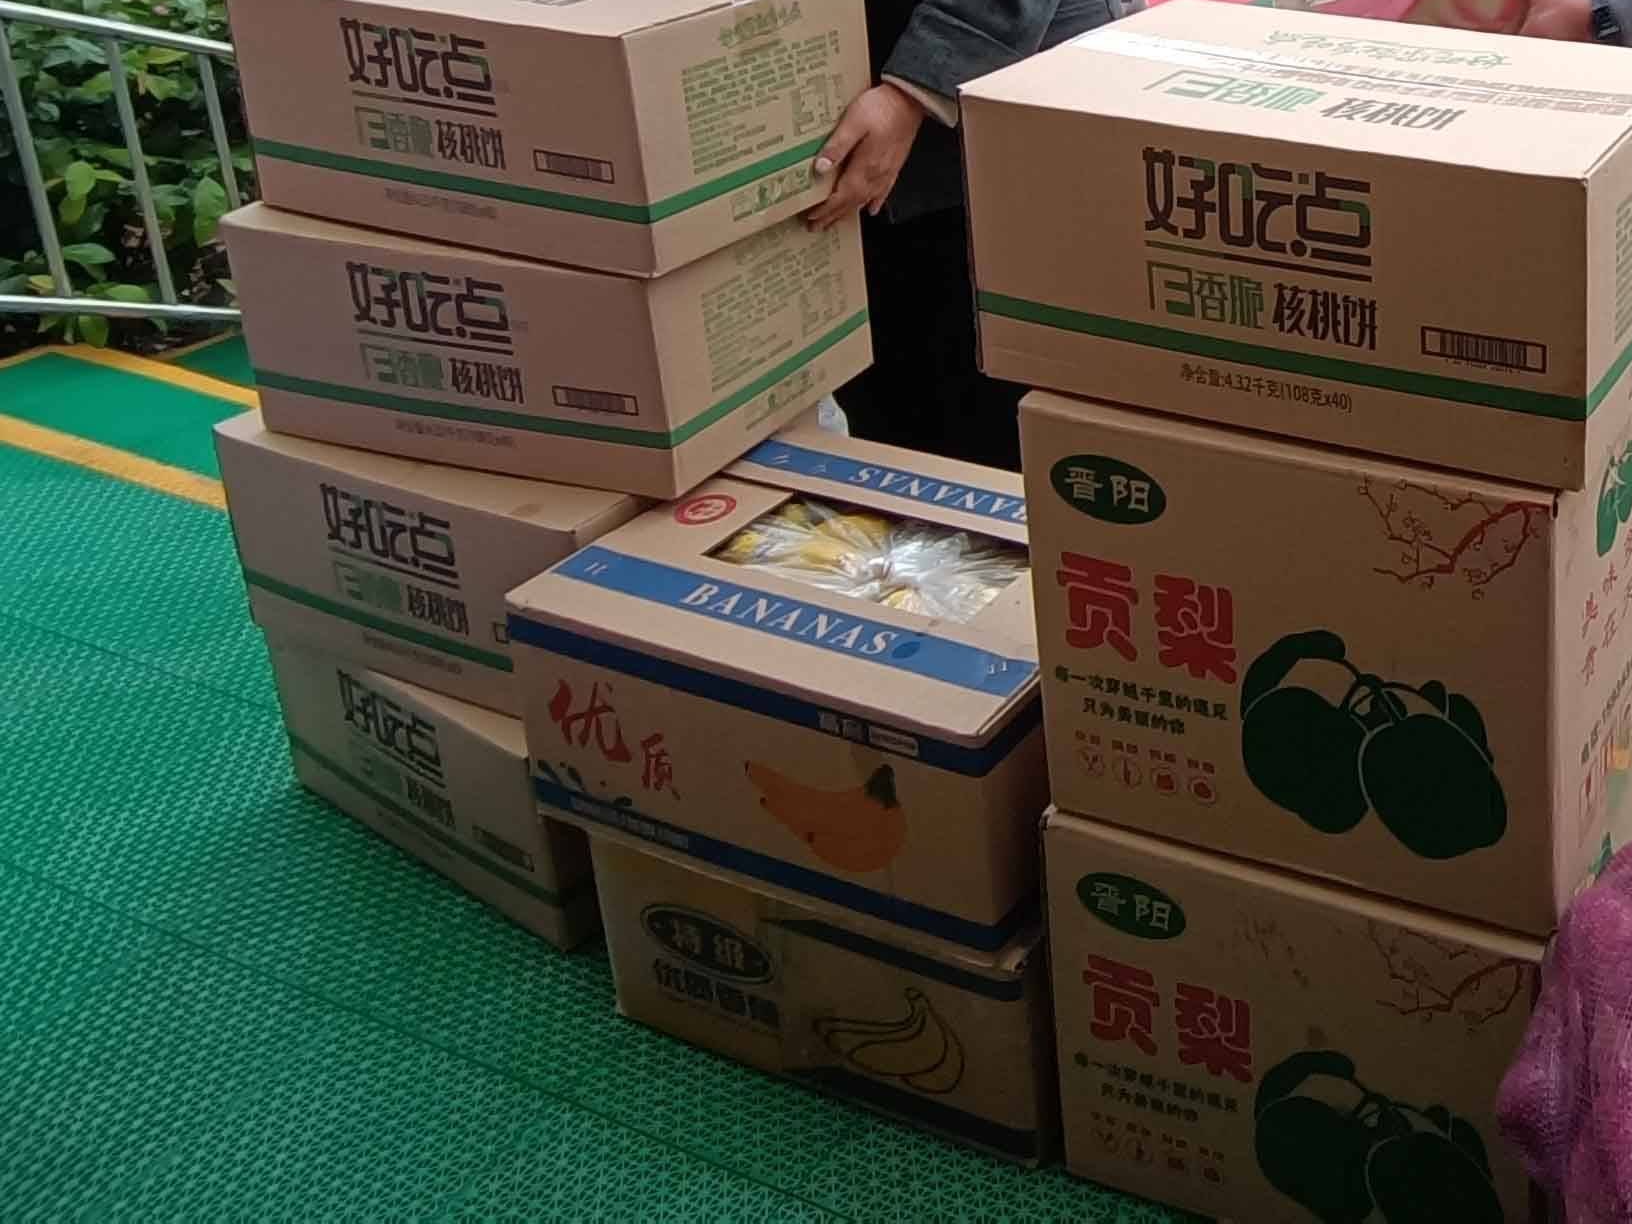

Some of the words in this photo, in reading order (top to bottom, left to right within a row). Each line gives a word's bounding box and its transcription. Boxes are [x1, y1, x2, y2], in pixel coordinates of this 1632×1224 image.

[339, 17, 496, 105] 好吃点
[1320, 95, 1468, 132] 核桃饼
[1142, 146, 1372, 267] 好吃点
[346, 261, 512, 344] 好吃点
[1272, 282, 1378, 350] 核桃饼
[320, 483, 459, 579] 好吃点
[1064, 466, 1151, 512] 晋阳
[680, 583, 898, 660] BANANAS
[1056, 551, 1238, 685] 贡梨
[548, 678, 682, 802] 优质
[1090, 882, 1172, 932] 晋阳
[1082, 953, 1254, 1084] 贡梨
